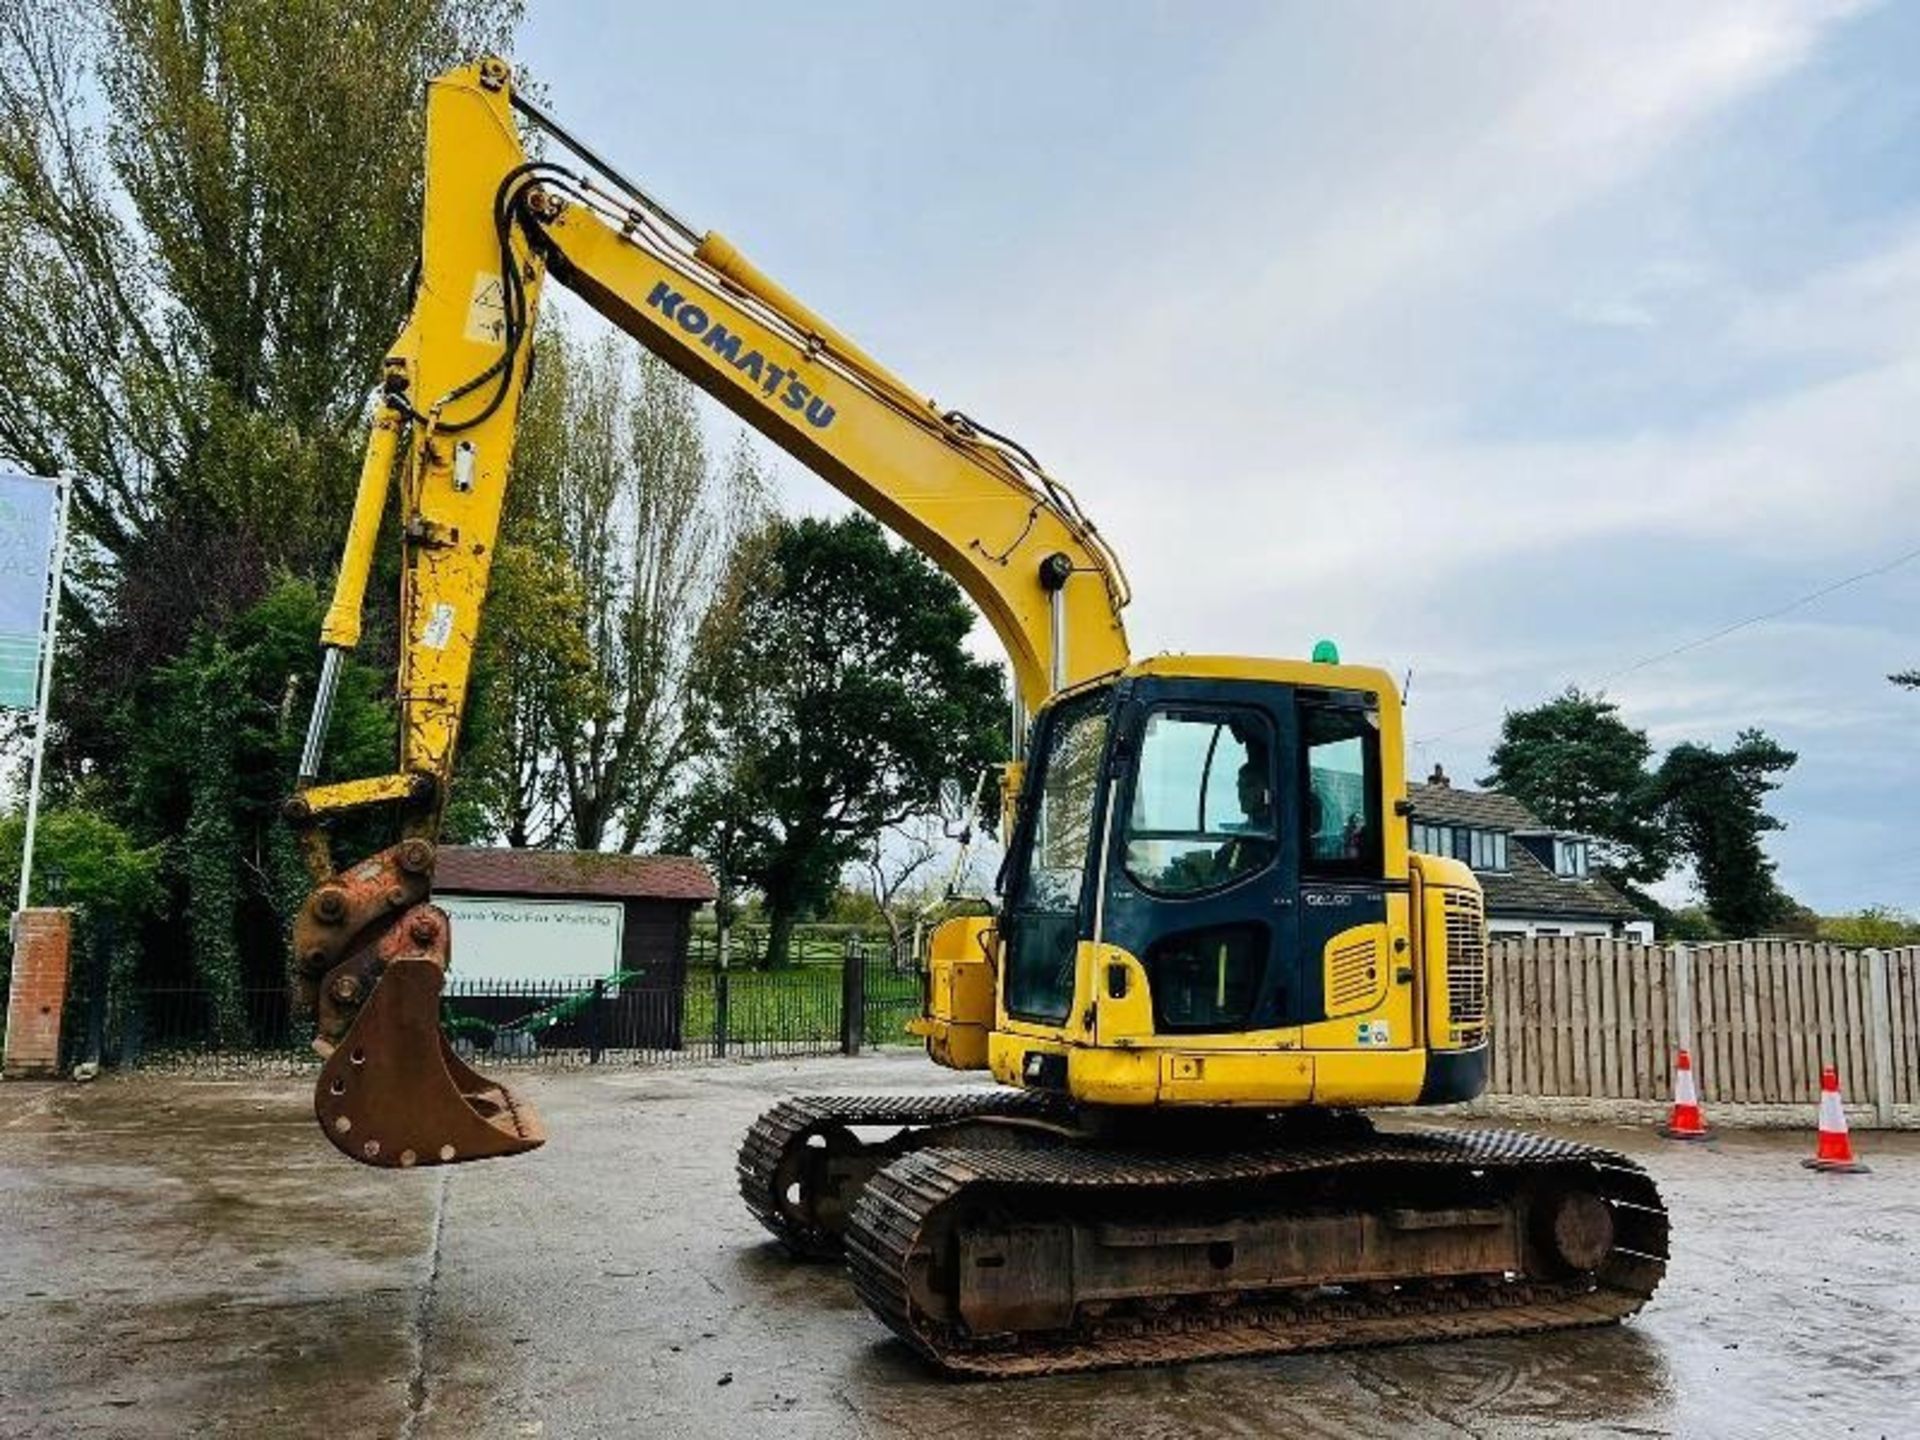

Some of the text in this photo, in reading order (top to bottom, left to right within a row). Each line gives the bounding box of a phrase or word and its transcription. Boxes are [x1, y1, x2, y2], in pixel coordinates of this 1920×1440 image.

[646, 281, 836, 428] KOMATSU
[491, 911, 521, 922] You
[525, 911, 549, 922] For
[553, 912, 611, 926] Visiting
